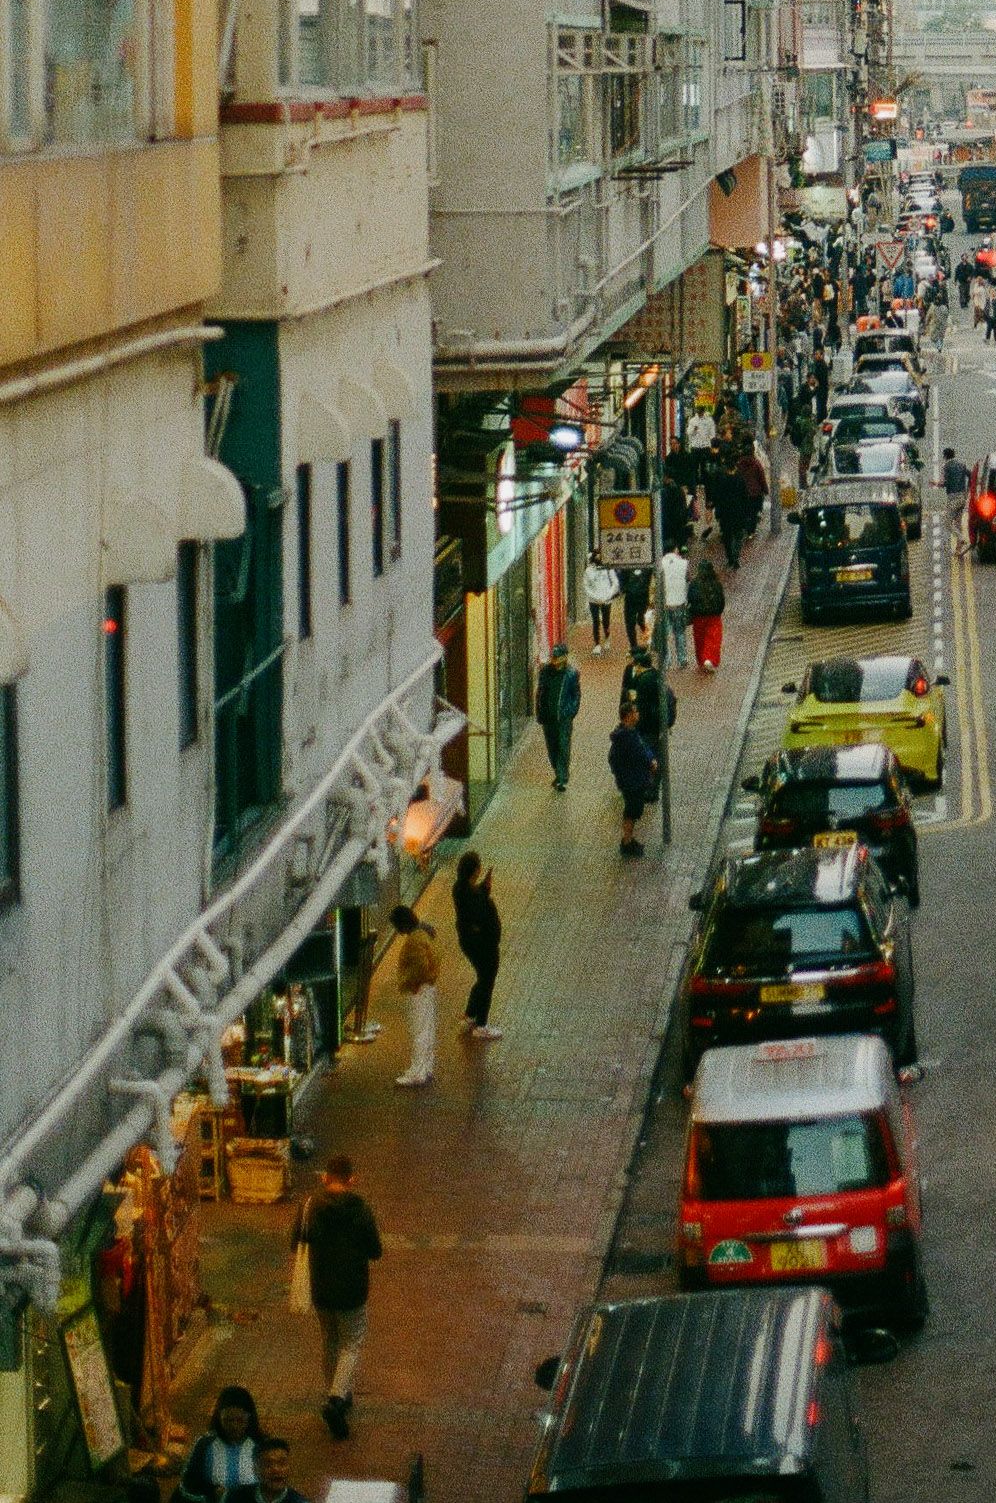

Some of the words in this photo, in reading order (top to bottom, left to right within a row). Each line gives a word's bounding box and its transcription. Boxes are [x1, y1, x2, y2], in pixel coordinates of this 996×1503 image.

[606, 532, 624, 544] 24
[626, 532, 646, 544] hrs
[610, 547, 644, 561] 全日
